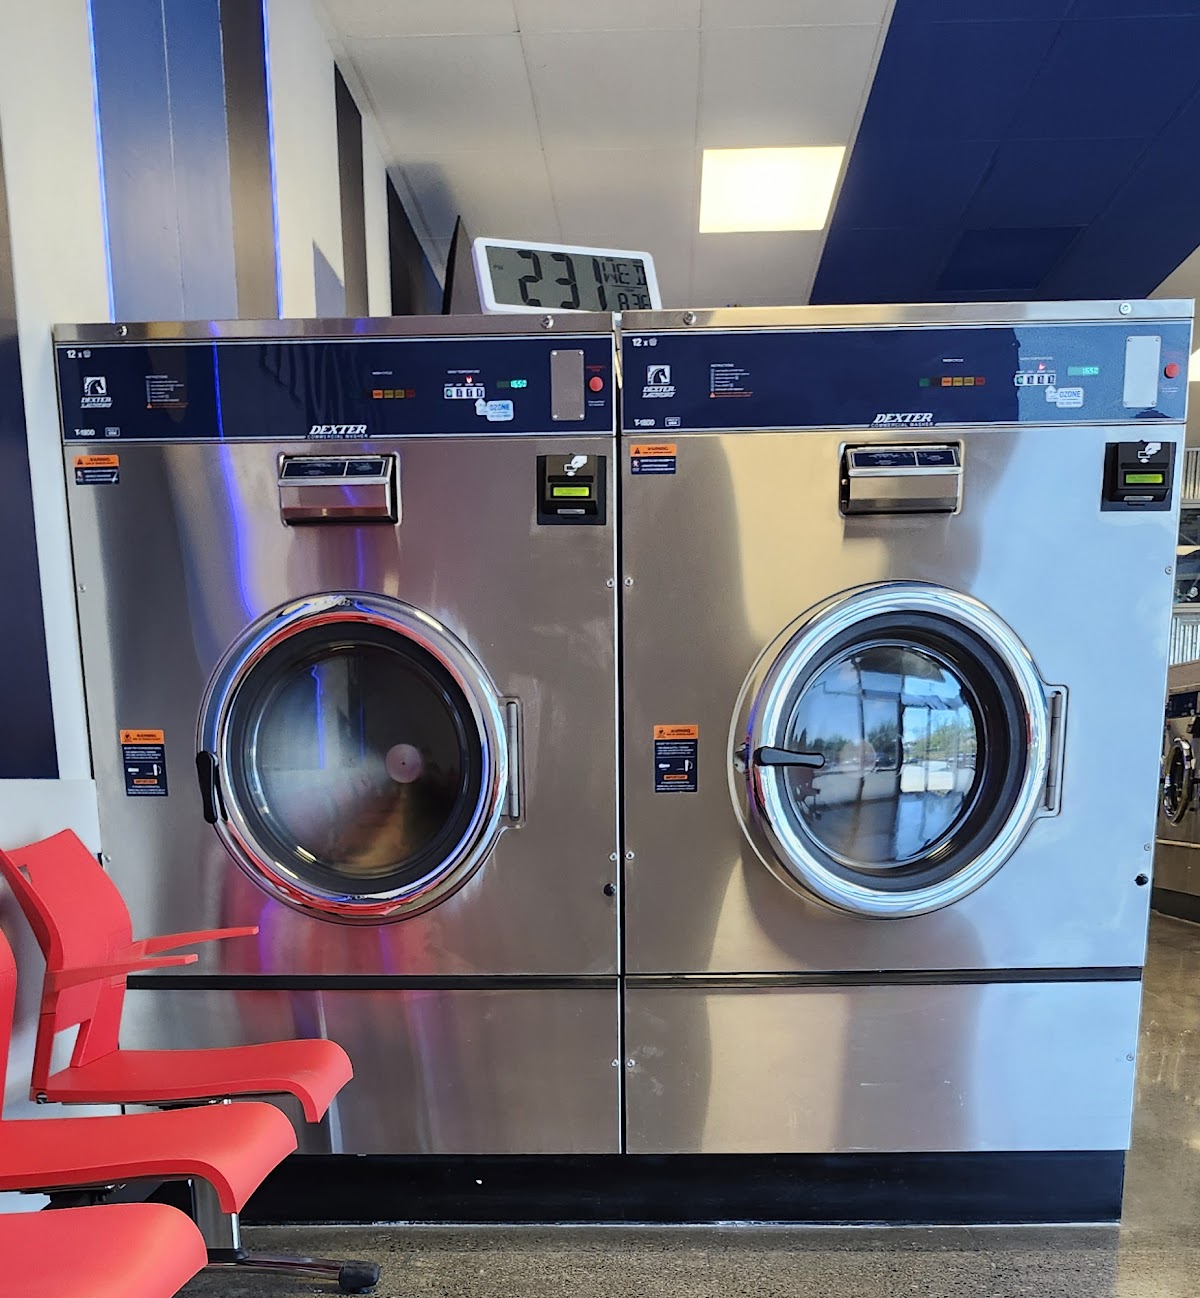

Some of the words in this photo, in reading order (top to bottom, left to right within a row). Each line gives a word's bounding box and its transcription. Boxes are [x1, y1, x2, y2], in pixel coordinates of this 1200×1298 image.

[602, 263, 647, 285] WED
[632, 338, 642, 347] 12
[67, 350, 76, 358] 12
[1059, 390, 1081, 398] OZONE
[489, 403, 510, 411] OZONE
[873, 413, 933, 423] DEXTER
[309, 425, 367, 435] DEXTER
